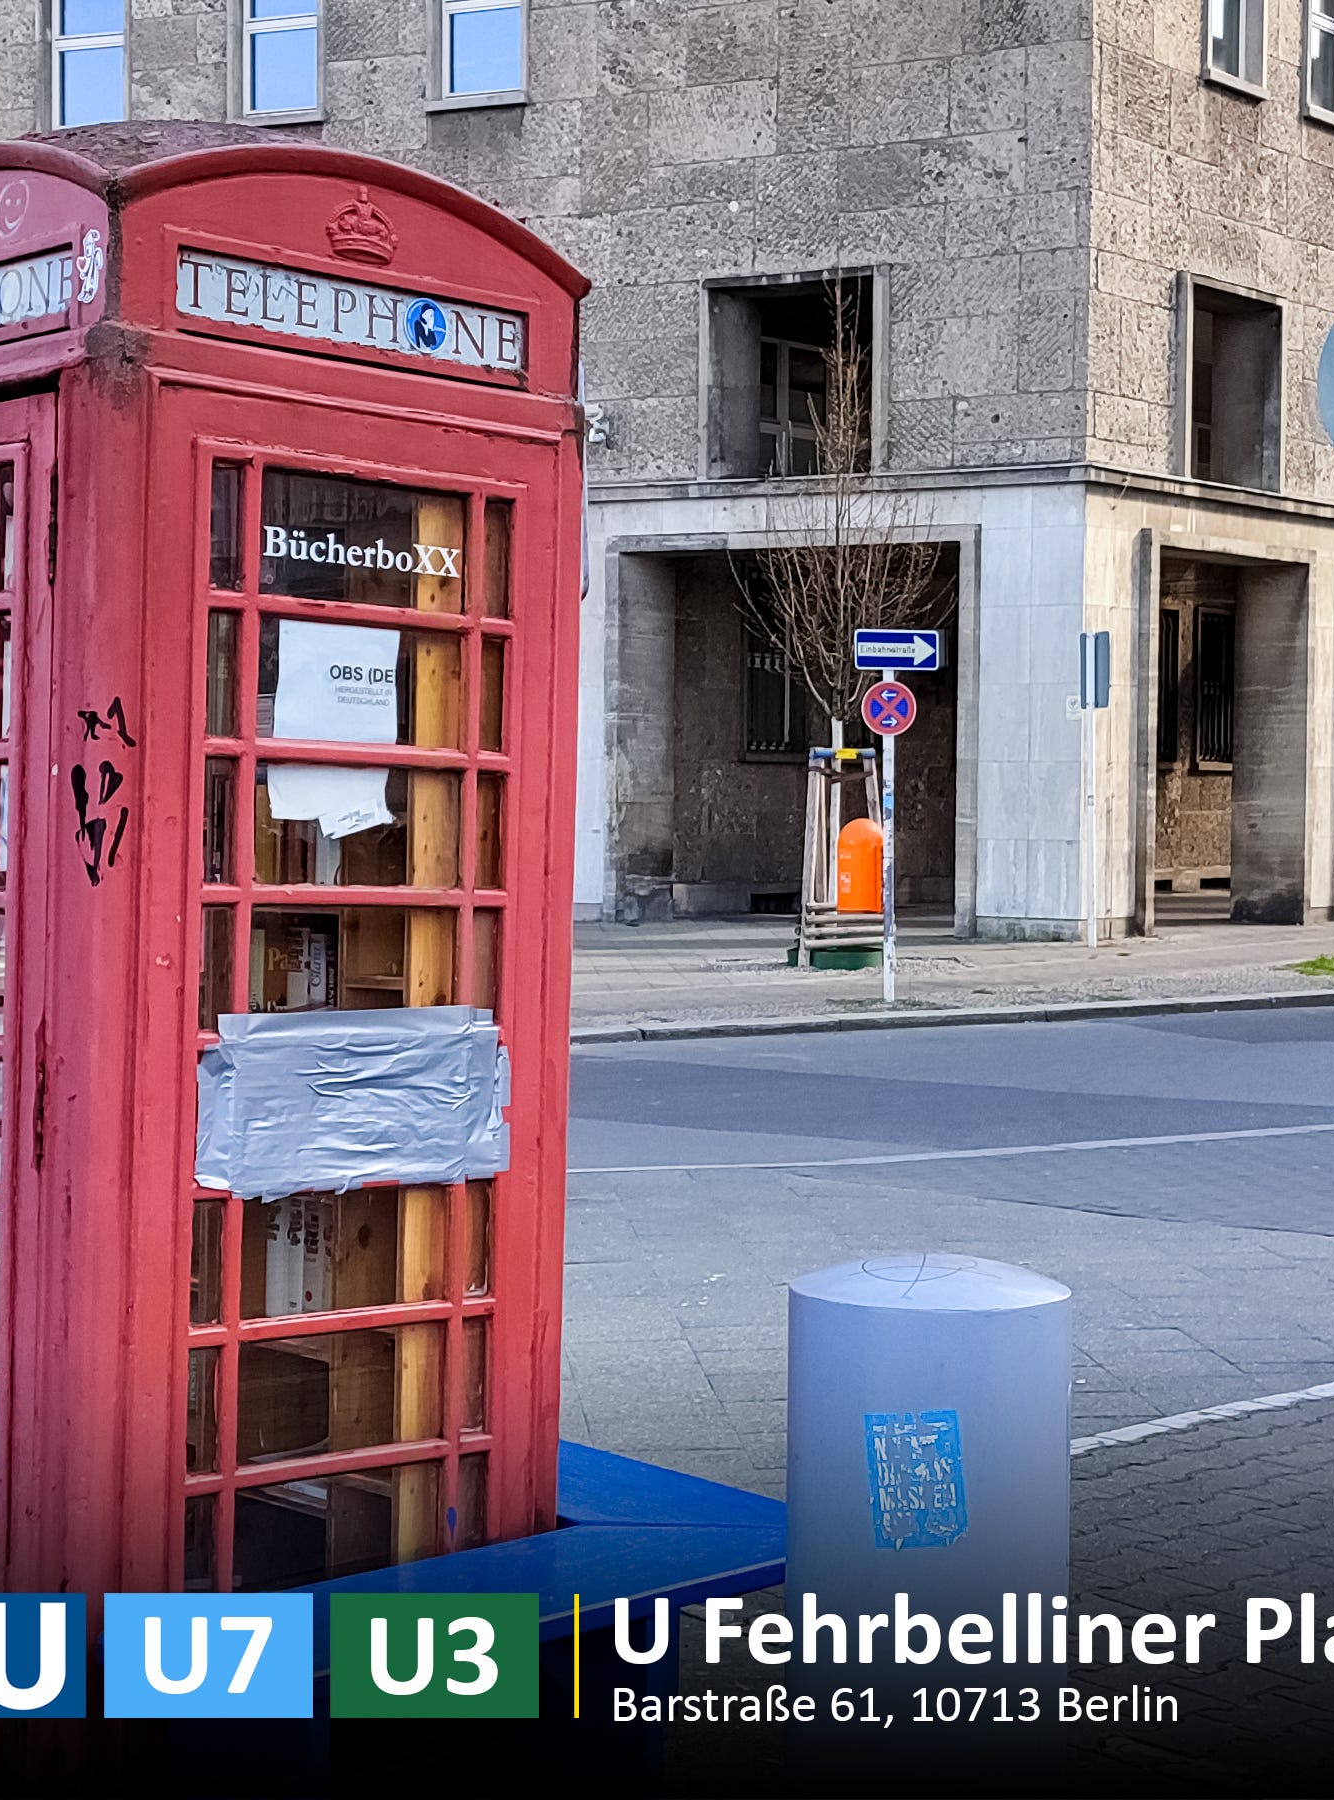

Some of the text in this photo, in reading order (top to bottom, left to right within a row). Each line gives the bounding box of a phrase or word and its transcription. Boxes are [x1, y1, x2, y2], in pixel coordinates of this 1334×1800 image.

[179, 254, 519, 364] TELEPHNE
[262, 525, 461, 578] BücherboXX
[860, 645, 916, 654] Einbahnstraße
[329, 664, 363, 681] OBS
[335, 685, 384, 696] HERGESTELLT
[337, 696, 390, 707] DEUTSCHLAND
